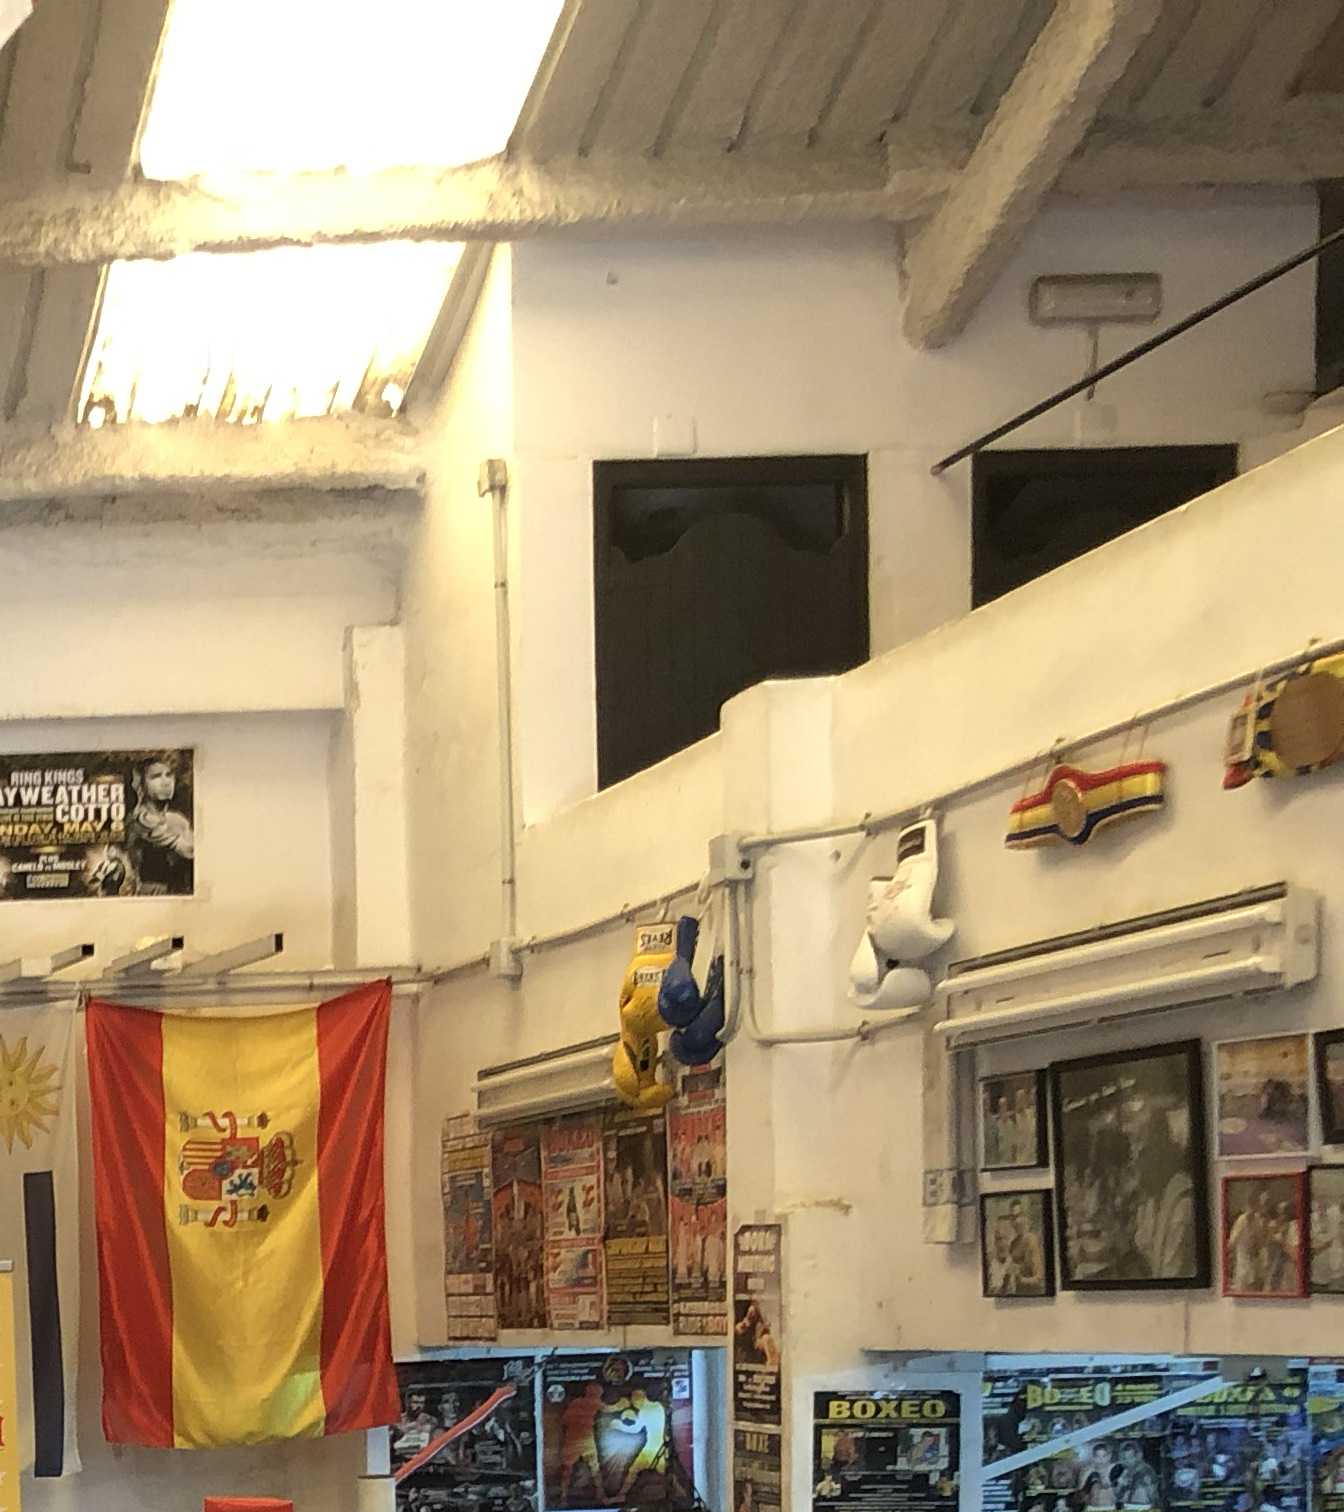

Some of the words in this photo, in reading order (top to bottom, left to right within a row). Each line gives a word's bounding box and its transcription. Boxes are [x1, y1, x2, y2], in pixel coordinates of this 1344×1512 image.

[11, 770, 42, 786] RING
[45, 768, 84, 785] KINGS
[56, 804, 125, 822] COTTO
[64, 821, 107, 832] MAY
[828, 1400, 946, 1419] BOXEO
